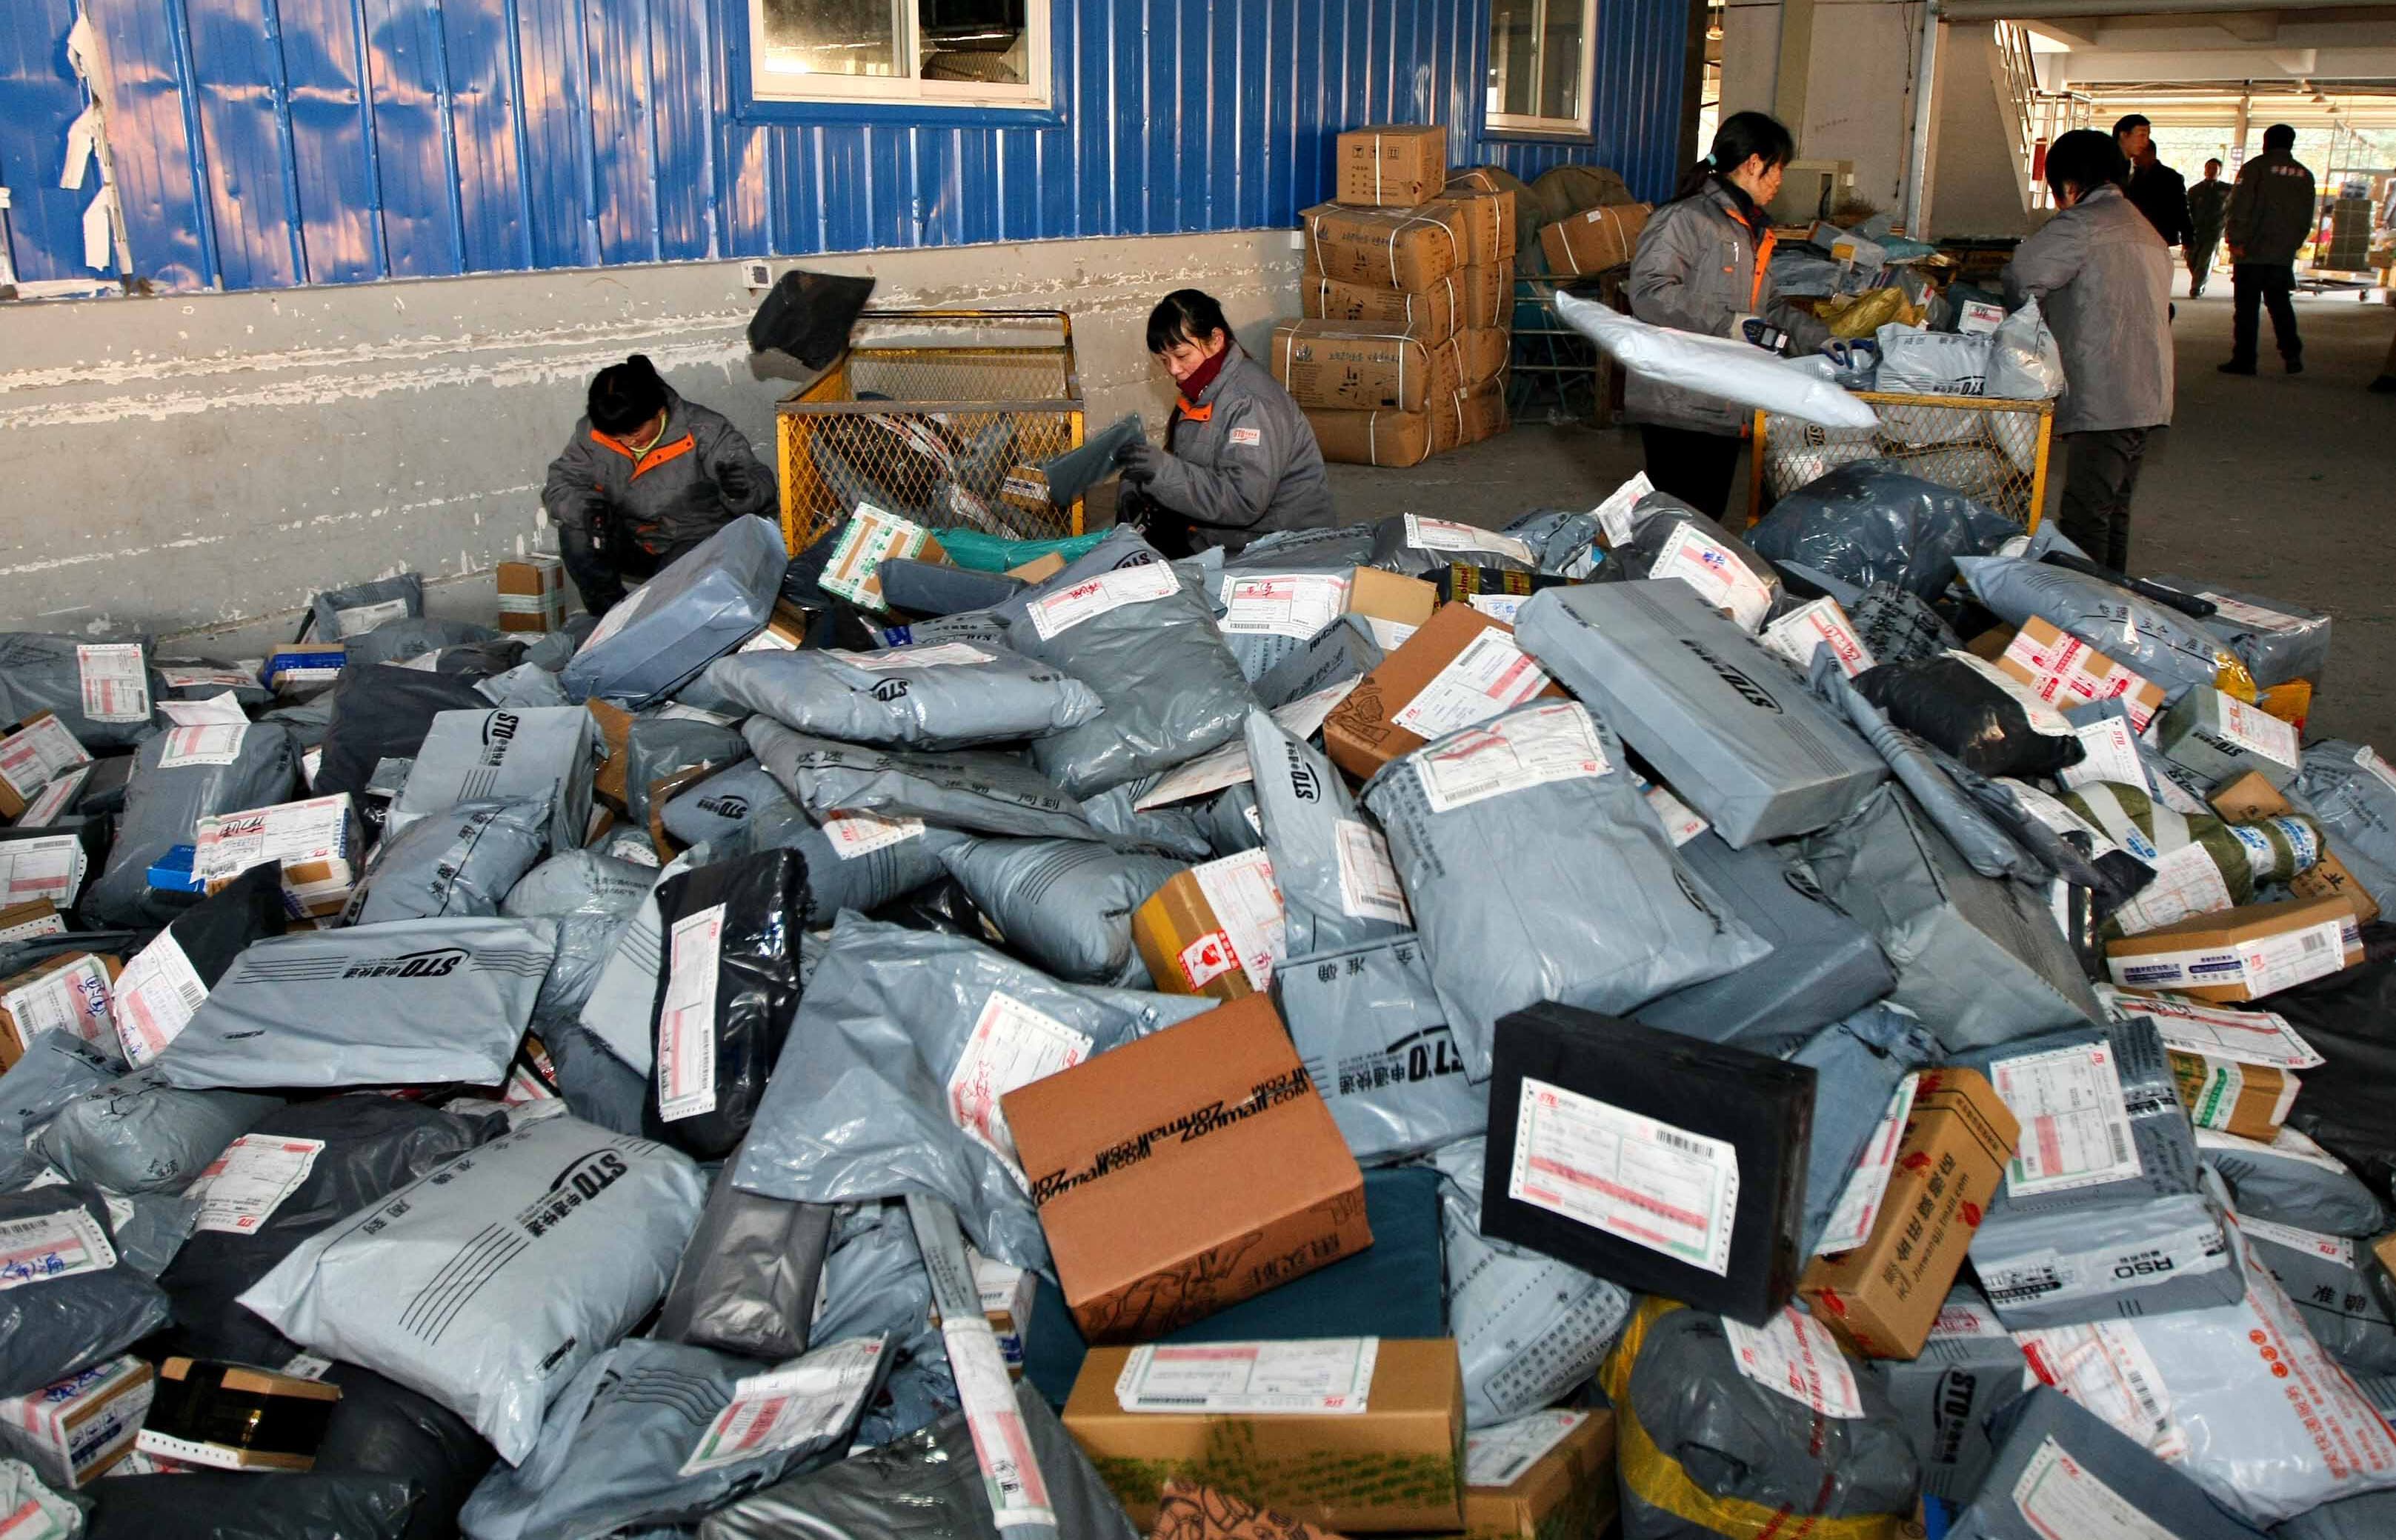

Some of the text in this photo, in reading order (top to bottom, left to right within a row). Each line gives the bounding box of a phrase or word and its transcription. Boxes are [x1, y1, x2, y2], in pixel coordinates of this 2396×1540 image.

[493, 713, 519, 741] STO
[1293, 771, 1314, 801] STO
[404, 955, 465, 978] STO
[1340, 1067, 1405, 1095] 申通快递
[571, 1152, 628, 1200] STO
[363, 1199, 410, 1236] 周到
[525, 1190, 583, 1239] 申通快递
[2114, 1258, 2175, 1281] RSO
[1946, 1370, 1976, 1418] STO
